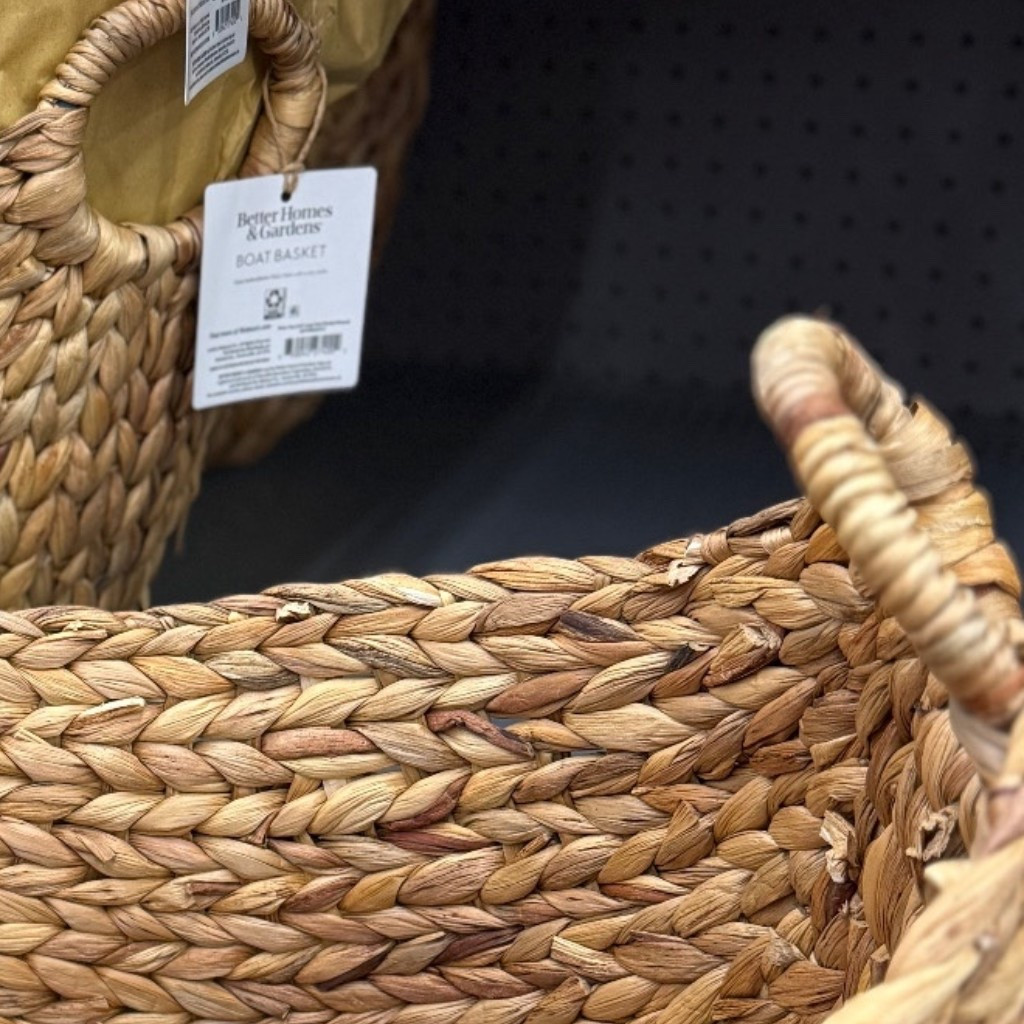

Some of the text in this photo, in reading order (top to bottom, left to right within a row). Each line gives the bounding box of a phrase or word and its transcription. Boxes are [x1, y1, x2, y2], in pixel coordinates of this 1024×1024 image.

[237, 206, 333, 228] Better Homes
[236, 244, 326, 268] BOAT BASKET
